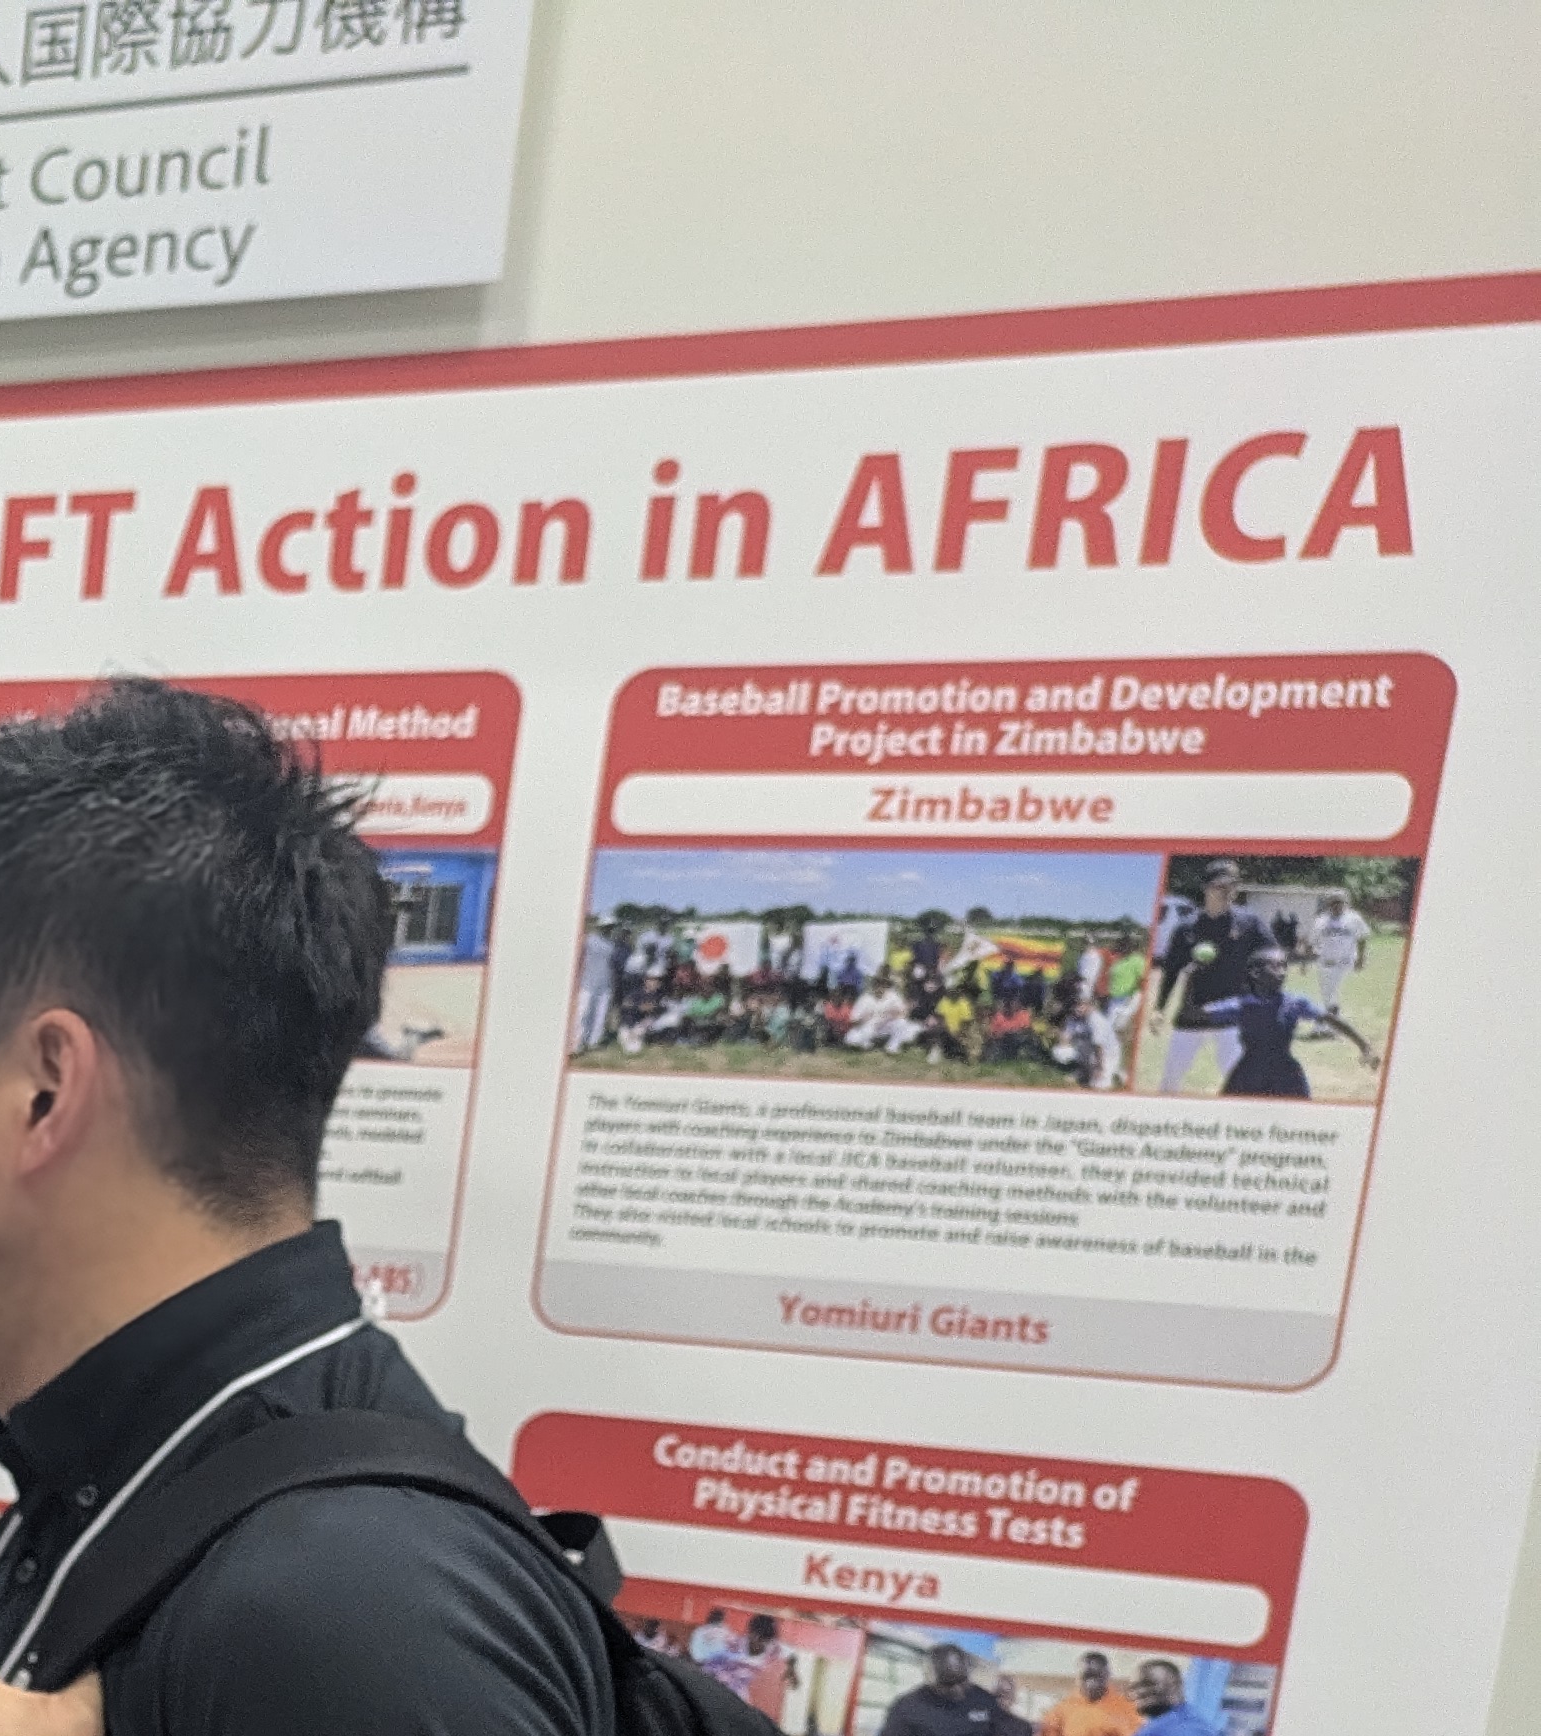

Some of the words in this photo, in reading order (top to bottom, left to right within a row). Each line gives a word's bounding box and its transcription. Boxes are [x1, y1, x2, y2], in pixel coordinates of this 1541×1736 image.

[30, 124, 273, 204] Council
[18, 219, 258, 300] Agency
[160, 468, 594, 602] Action
[635, 457, 775, 583] in
[813, 424, 1422, 579] AFRICA
[345, 702, 481, 741] Method
[656, 680, 810, 719] Baseball
[816, 677, 1018, 719] Promotion
[1024, 674, 1108, 715] and
[1112, 673, 1396, 719] Development
[807, 721, 946, 767] Project
[948, 719, 988, 758] in
[994, 716, 1206, 759] Zimbabwe
[864, 783, 1118, 826] Zimbabwe
[1109, 1117, 1221, 1139] dispatched
[1268, 1124, 1338, 1143] former
[1285, 1201, 1326, 1218] and
[1167, 1238, 1253, 1259] baseball
[1282, 1245, 1319, 1264] the
[776, 1292, 923, 1336] Yomiuri
[928, 1303, 1054, 1347] Giants
[651, 1432, 799, 1484] Conduct
[803, 1452, 879, 1492] and
[881, 1450, 1088, 1512] Promotion
[1092, 1476, 1143, 1514] of
[692, 1479, 844, 1531] Physical
[845, 1492, 979, 1540] Fitness
[984, 1505, 1087, 1551] Tests
[801, 1552, 944, 1603] Kenya
